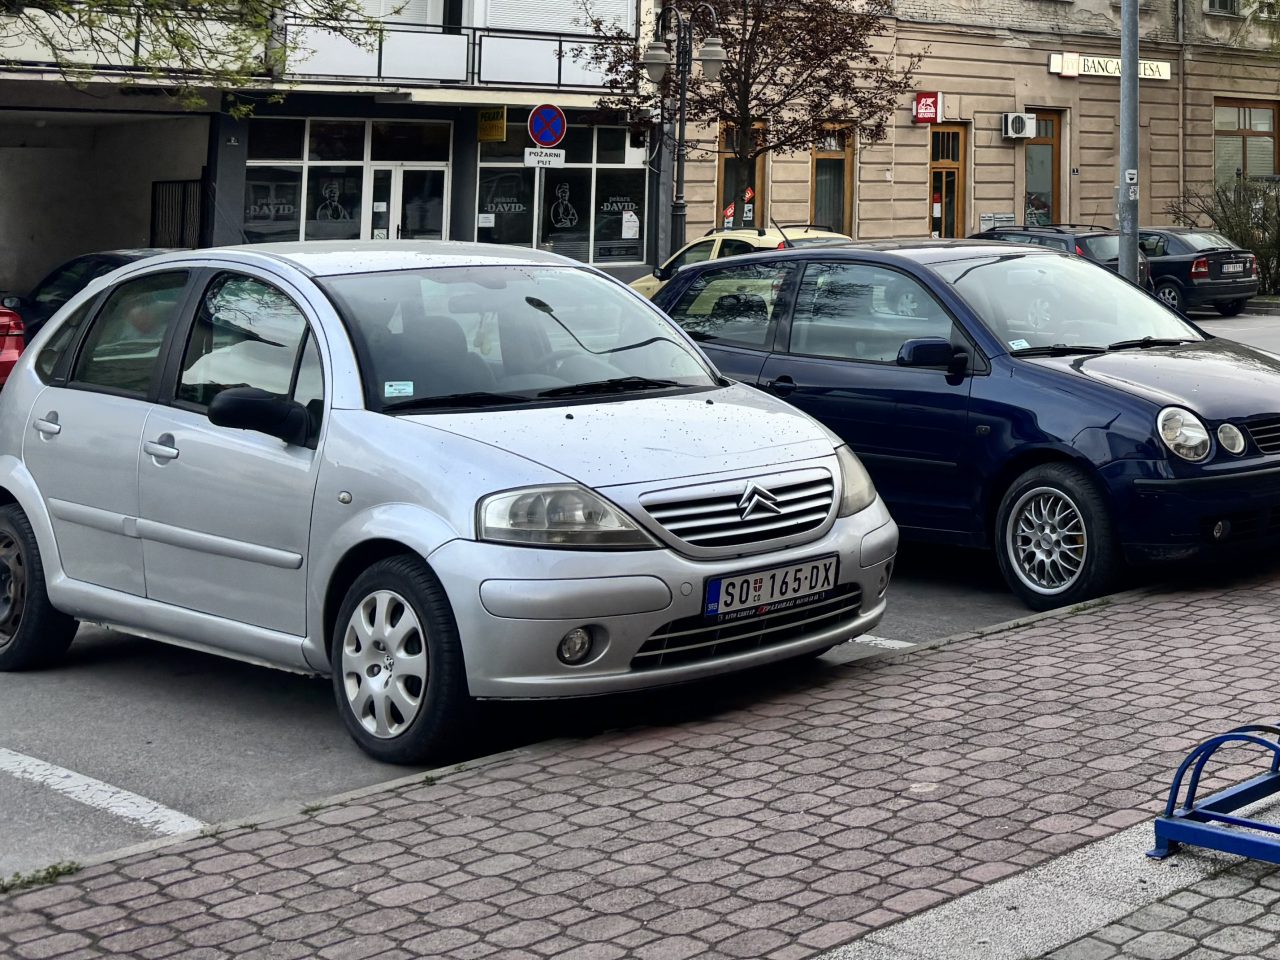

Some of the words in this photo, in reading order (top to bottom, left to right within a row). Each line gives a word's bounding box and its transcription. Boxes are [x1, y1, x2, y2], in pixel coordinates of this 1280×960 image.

[1083, 57, 1121, 73] BANCA
[529, 150, 561, 158] POŽARNI
[723, 579, 751, 608] SO
